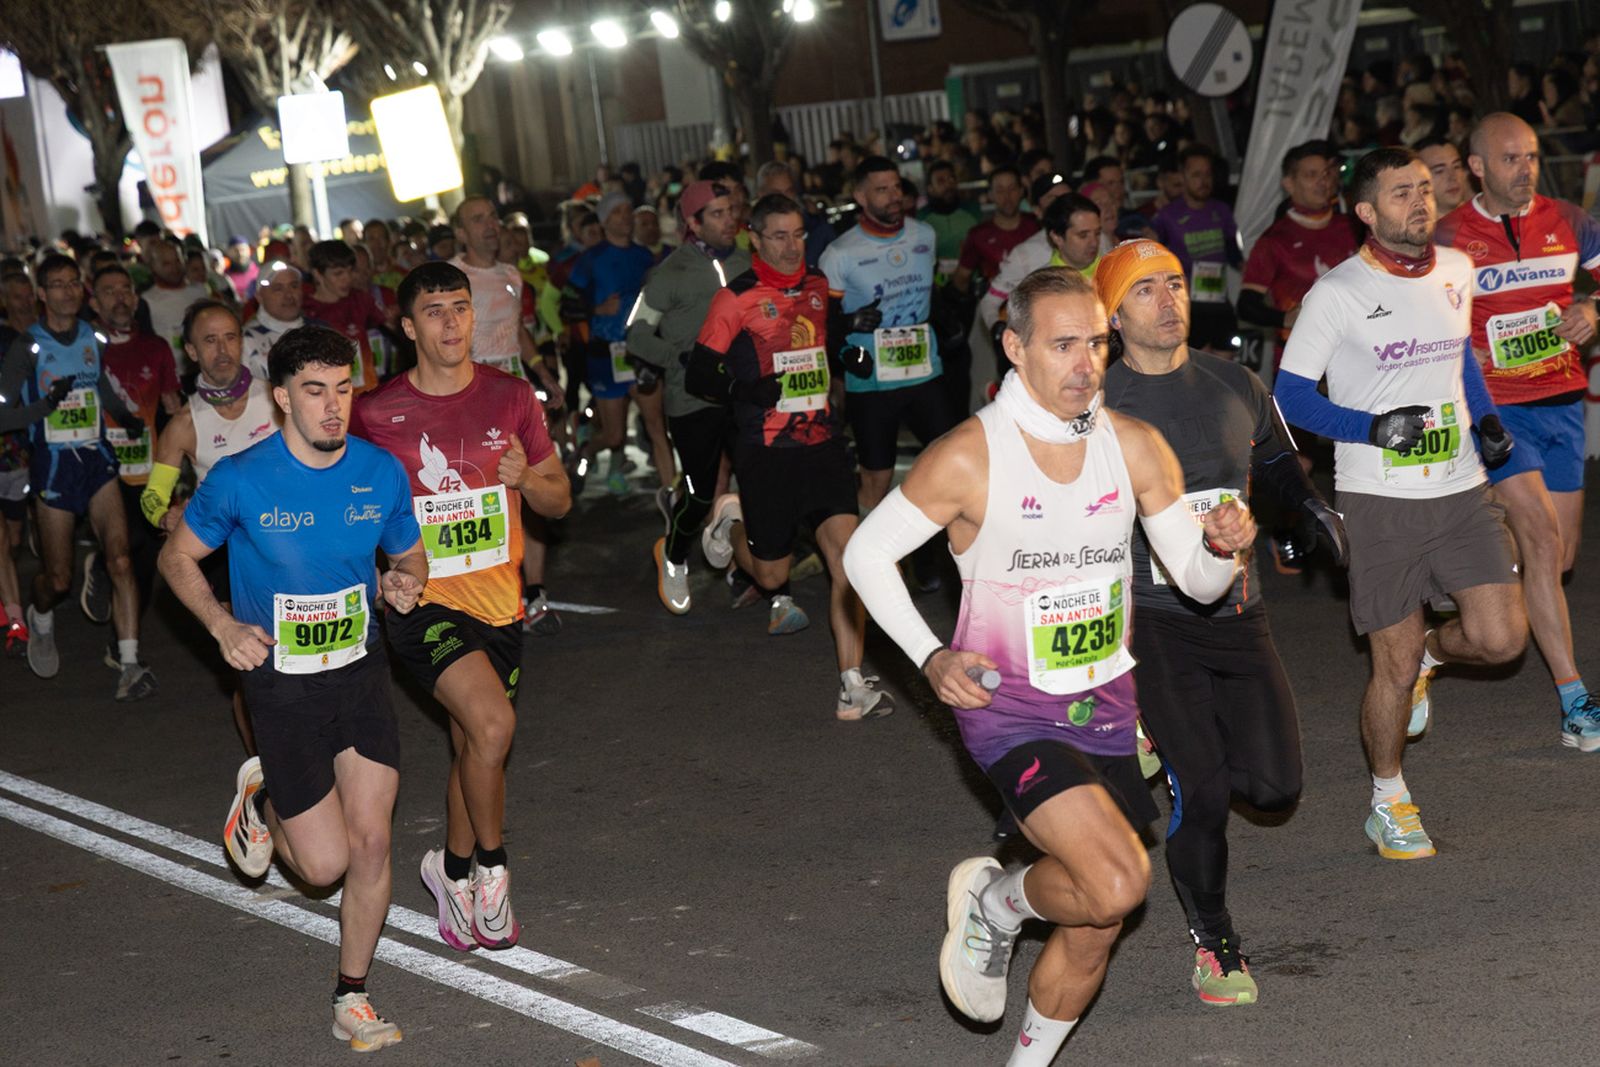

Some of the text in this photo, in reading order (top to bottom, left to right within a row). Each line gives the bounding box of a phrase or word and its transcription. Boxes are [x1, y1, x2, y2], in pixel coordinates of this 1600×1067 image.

[1505, 267, 1566, 284] Avanza
[1498, 330, 1514, 339] SAN
[1500, 327, 1561, 360] 13065
[887, 345, 921, 362] 2363
[788, 369, 824, 391] 4034
[60, 408, 88, 424] 254
[435, 502, 462, 512] NOCHE
[463, 500, 474, 508] DE
[1201, 501, 1212, 511] DE
[260, 506, 315, 532] olaya
[426, 515, 444, 524] SAN
[438, 517, 492, 548] 4134
[1007, 549, 1060, 572] SIERRA
[1063, 553, 1076, 564] DE
[296, 602, 325, 612] NOCHE
[326, 601, 338, 610] DE
[1053, 596, 1086, 610] NOCHE
[1089, 592, 1101, 604] DE
[285, 612, 305, 622] SAN
[1040, 612, 1064, 625] SAN
[295, 617, 353, 647] 9072
[1051, 613, 1116, 657] 4235
